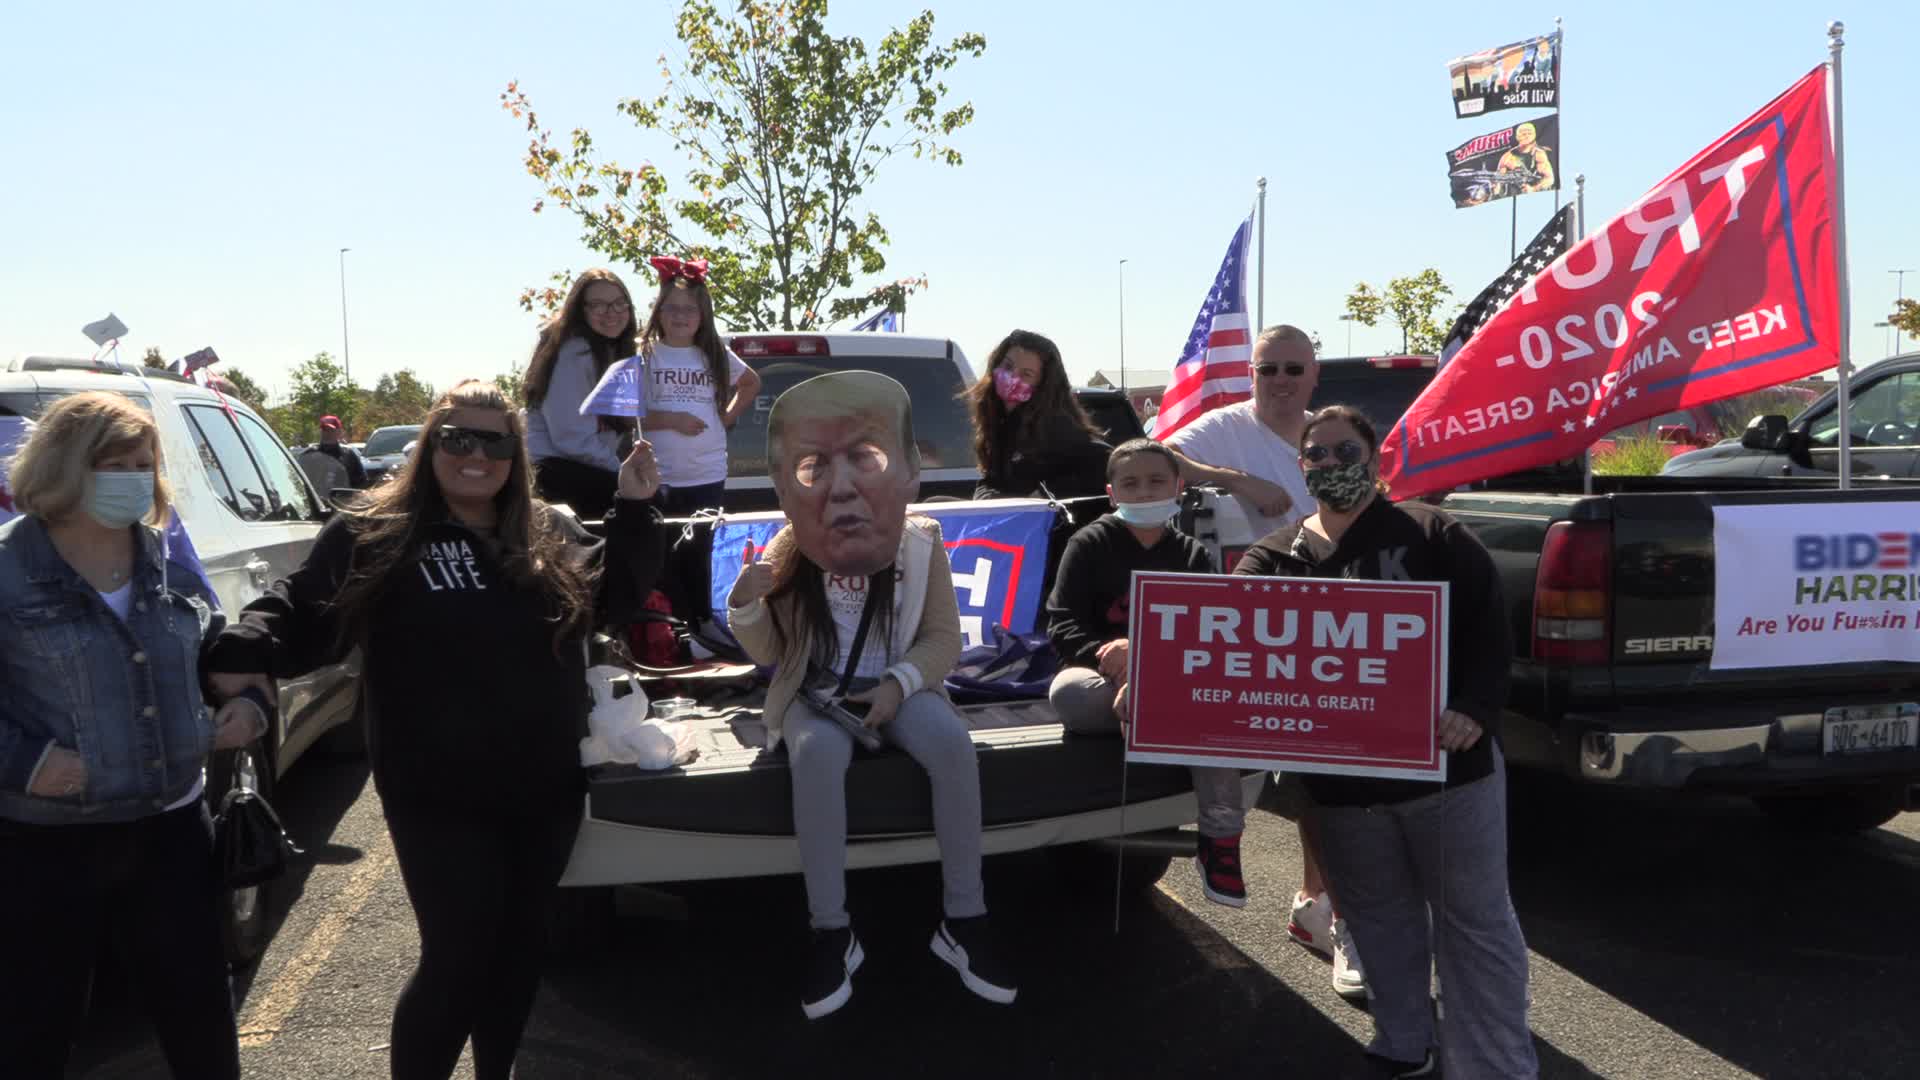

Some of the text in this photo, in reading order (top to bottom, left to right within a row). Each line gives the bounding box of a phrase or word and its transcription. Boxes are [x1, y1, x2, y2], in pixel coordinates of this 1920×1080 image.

[425, 539, 475, 561] AMA
[419, 560, 487, 590] LIFE
[1795, 574, 1920, 605] HARRI
[1150, 603, 1426, 650] TRUMP
[1737, 615, 1777, 637] Are
[1787, 613, 1825, 633] You
[1183, 650, 1387, 684] PENCE
[1192, 688, 1375, 711] KEEP AMERICA GREAT!
